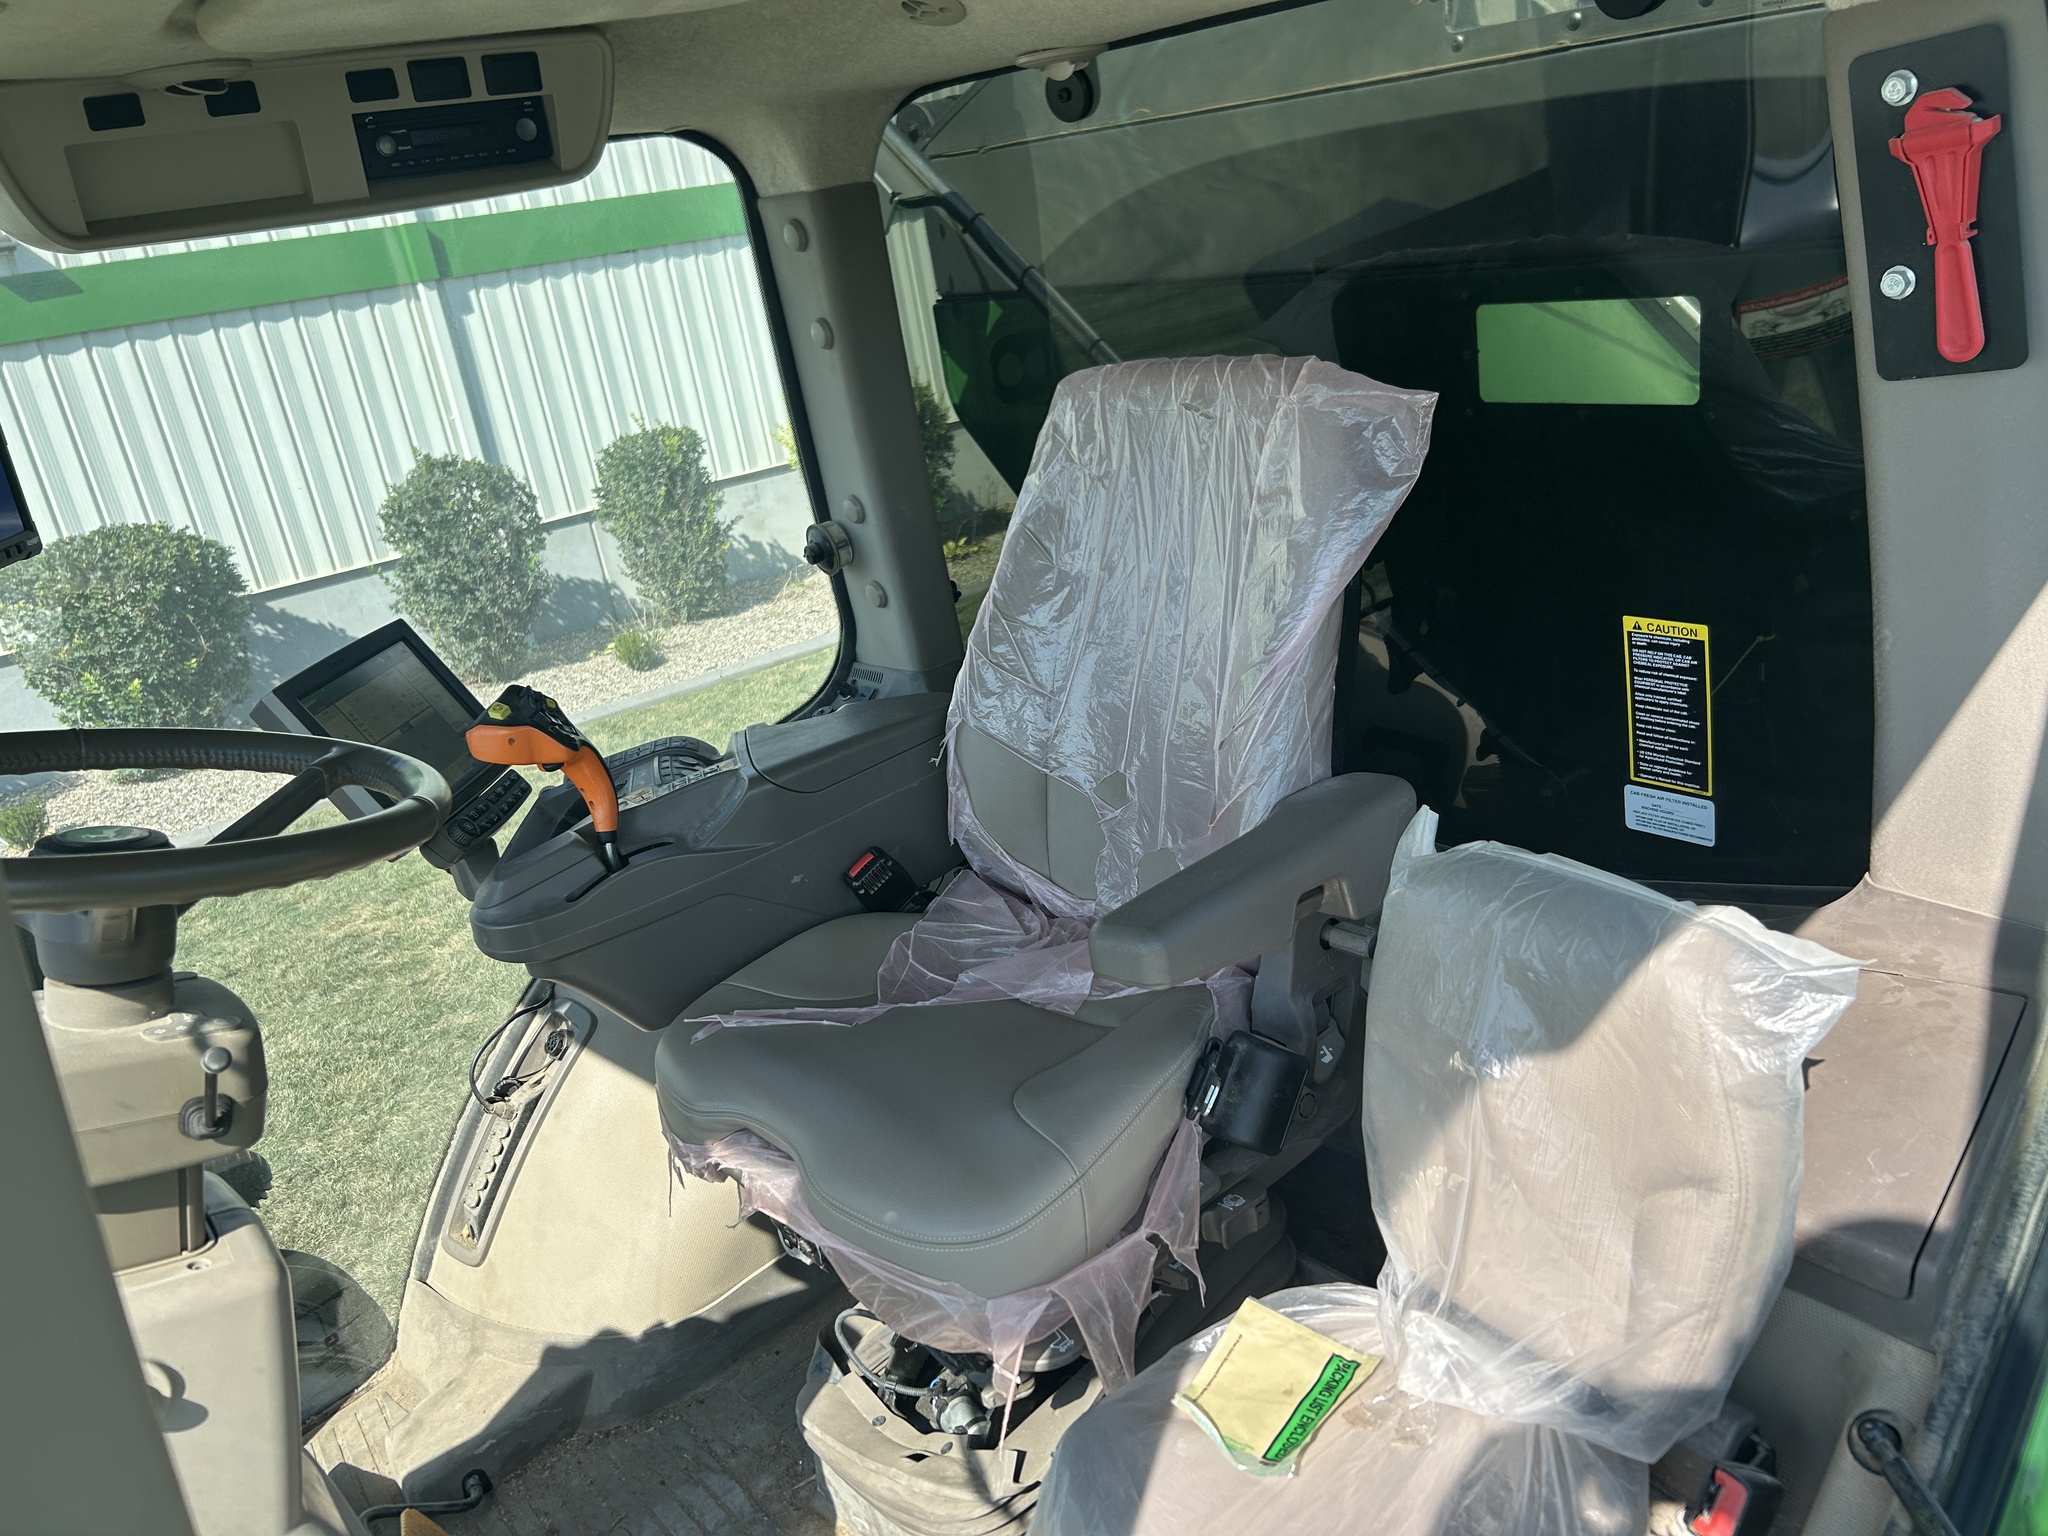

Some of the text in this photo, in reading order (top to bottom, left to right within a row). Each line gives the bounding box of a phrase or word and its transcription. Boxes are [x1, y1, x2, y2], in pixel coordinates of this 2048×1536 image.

[1647, 623, 1698, 638] CAUTION
[1682, 801, 1707, 810] INSTALLED
[1275, 1360, 1351, 1461] PACKING LIST ENCLOSED
